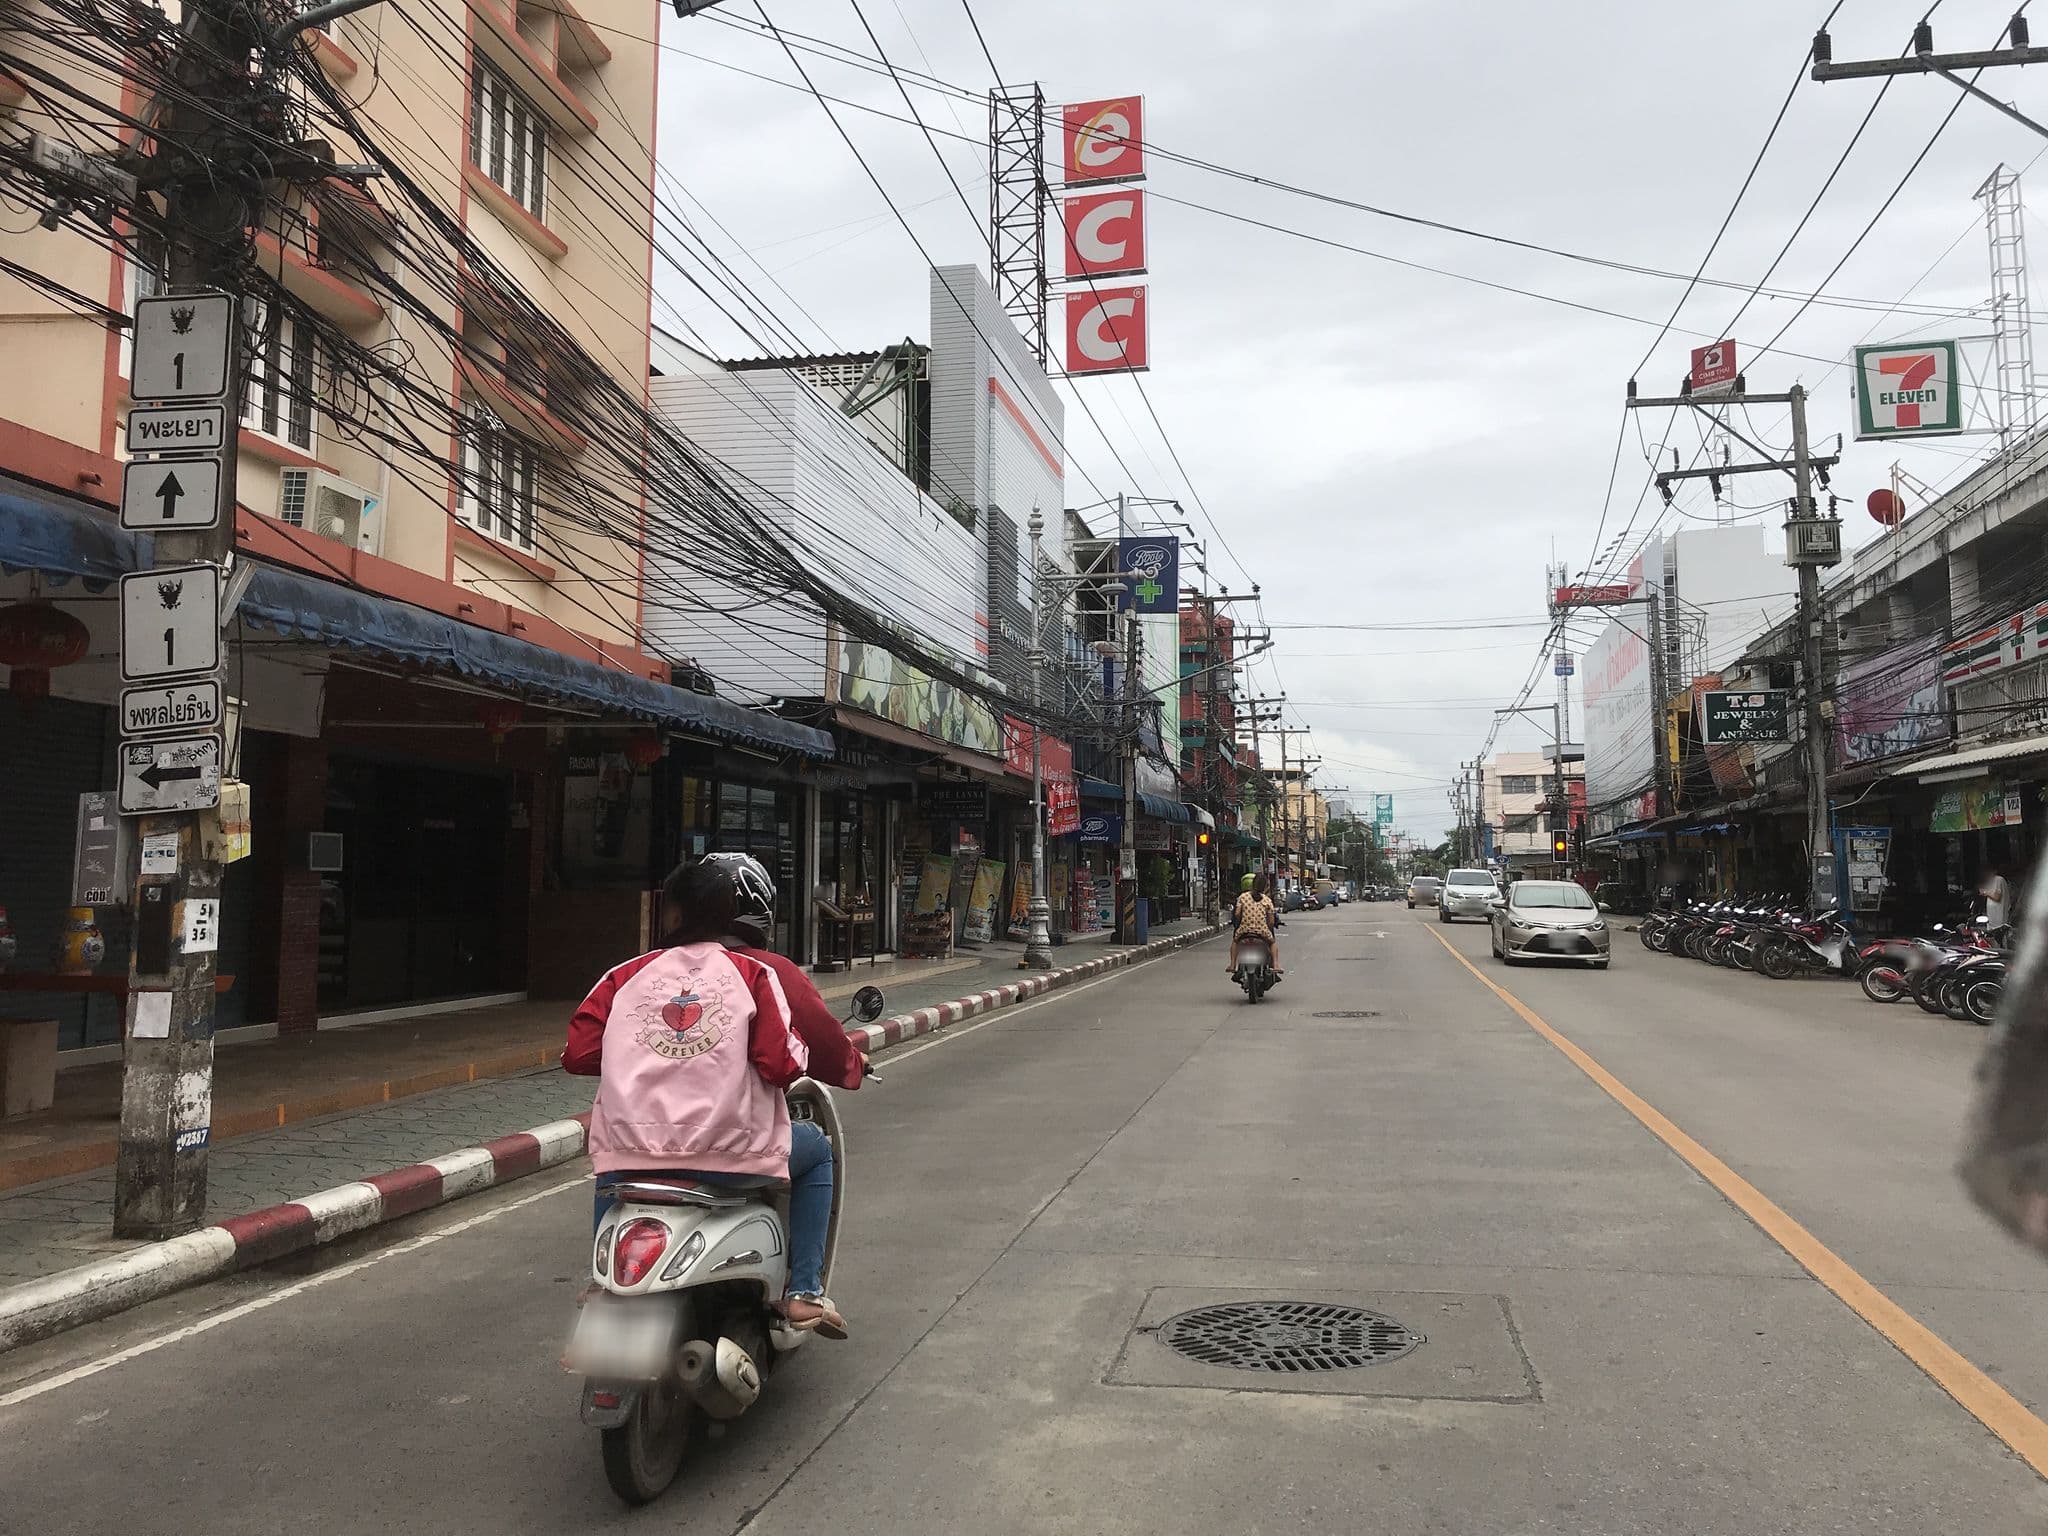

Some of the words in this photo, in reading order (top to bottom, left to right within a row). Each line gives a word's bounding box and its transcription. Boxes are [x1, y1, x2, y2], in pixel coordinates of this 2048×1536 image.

[173, 353, 184, 390] 1
[1879, 354, 1936, 427] 7
[139, 418, 213, 440] พะเยา
[163, 627, 175, 666] 1
[130, 690, 211, 727] พหลโยธิน
[1726, 694, 1765, 708] T.S
[1740, 718, 1752, 730] &
[1080, 834, 1109, 843] pharmacy
[86, 890, 106, 902] COD
[191, 928, 207, 942] 35
[655, 1036, 714, 1058] FOREVER
